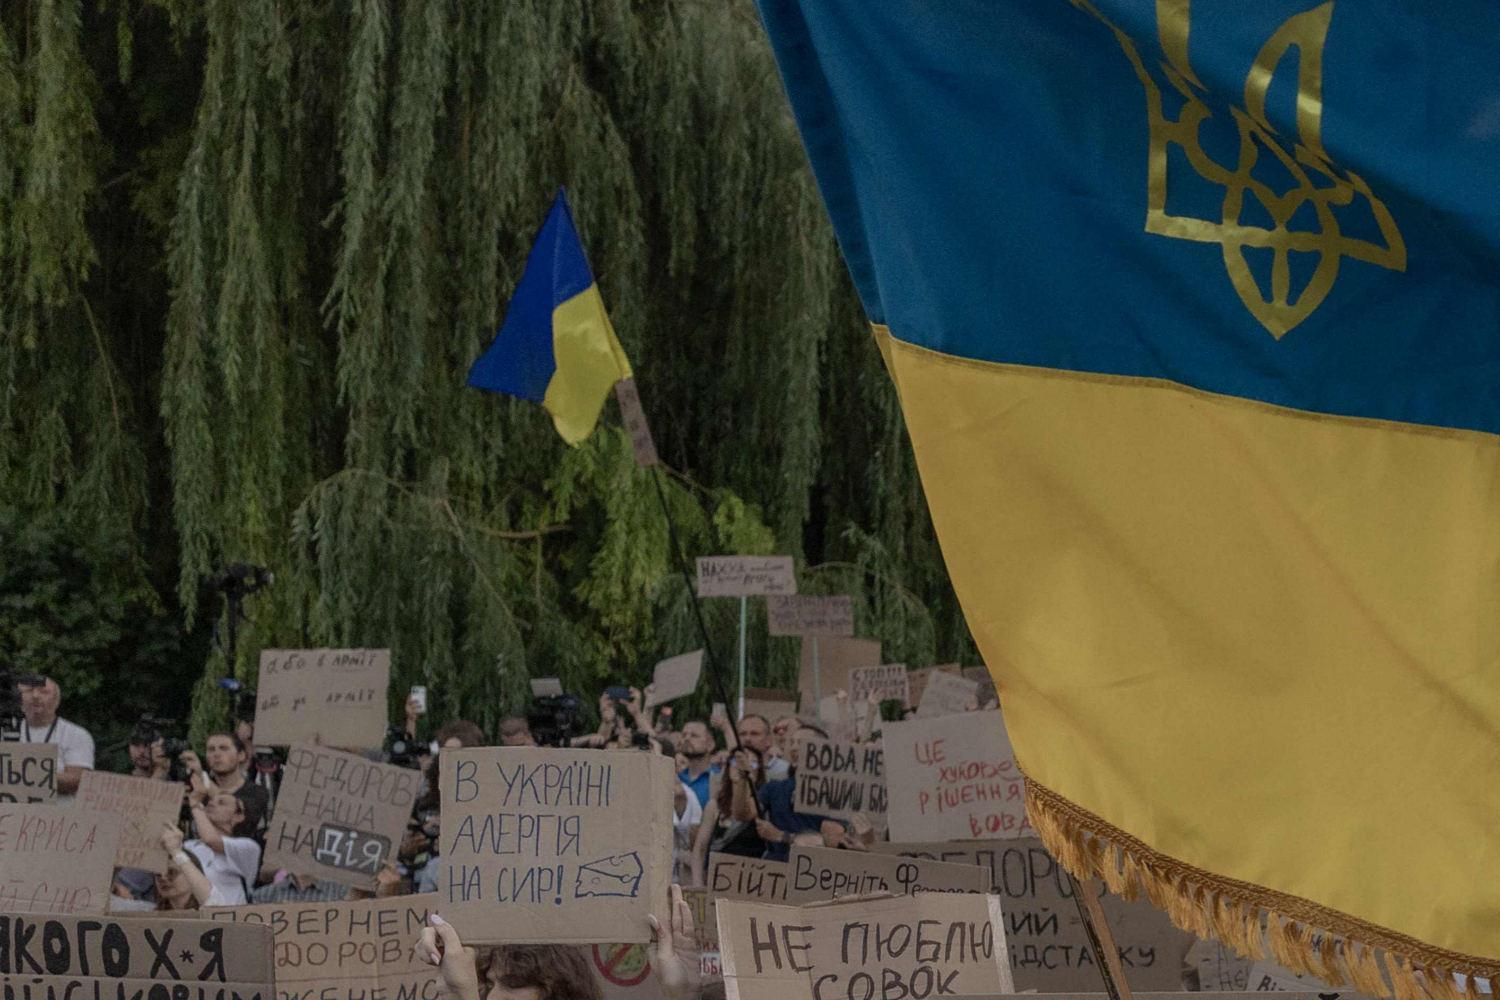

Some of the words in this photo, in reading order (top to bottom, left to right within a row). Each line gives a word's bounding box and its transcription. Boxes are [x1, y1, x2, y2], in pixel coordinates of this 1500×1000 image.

[914, 740, 947, 767] ЦЕ
[288, 749, 412, 807] ФЕДОРОВ
[455, 760, 479, 803] В
[497, 760, 612, 807] УКРАЇНІ
[918, 783, 1020, 815] РІШЕННЯ
[301, 790, 374, 830] НАША
[450, 813, 581, 856] АЛЕРГІЯ
[449, 865, 482, 903] НА
[497, 865, 564, 906] СИР!
[748, 917, 815, 974] НЕ
